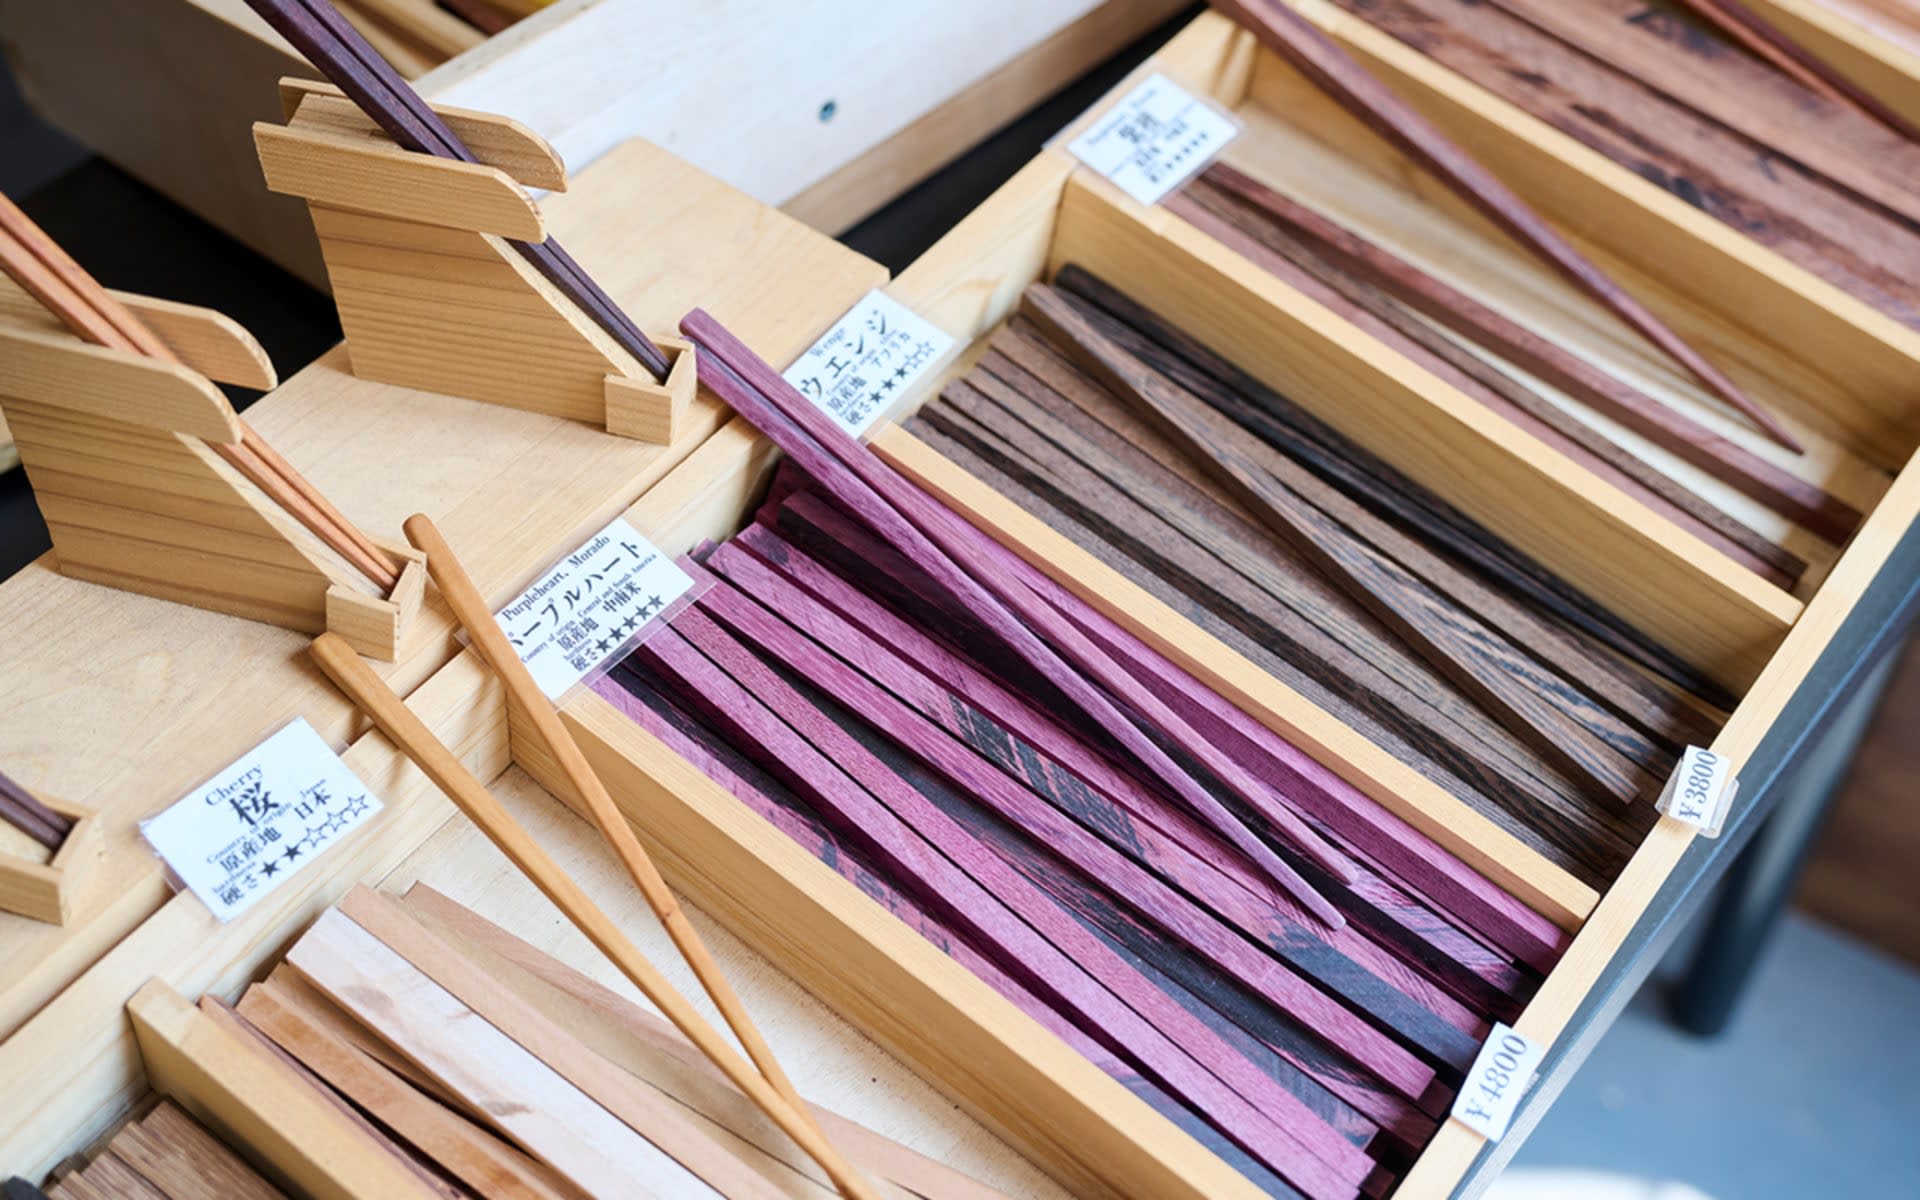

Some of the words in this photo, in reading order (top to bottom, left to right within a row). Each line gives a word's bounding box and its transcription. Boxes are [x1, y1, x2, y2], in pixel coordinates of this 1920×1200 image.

[568, 536, 610, 568] Morado
[557, 617, 599, 651] 原産地
[602, 581, 641, 613] 中南米
[205, 764, 263, 806] Cherry
[229, 780, 280, 826] 桜
[1678, 751, 1718, 820] ¥3800
[219, 827, 282, 875] 原産地
[293, 789, 331, 820] 日本
[219, 874, 258, 906] 硬さ
[1464, 1034, 1528, 1121] ¥4800
